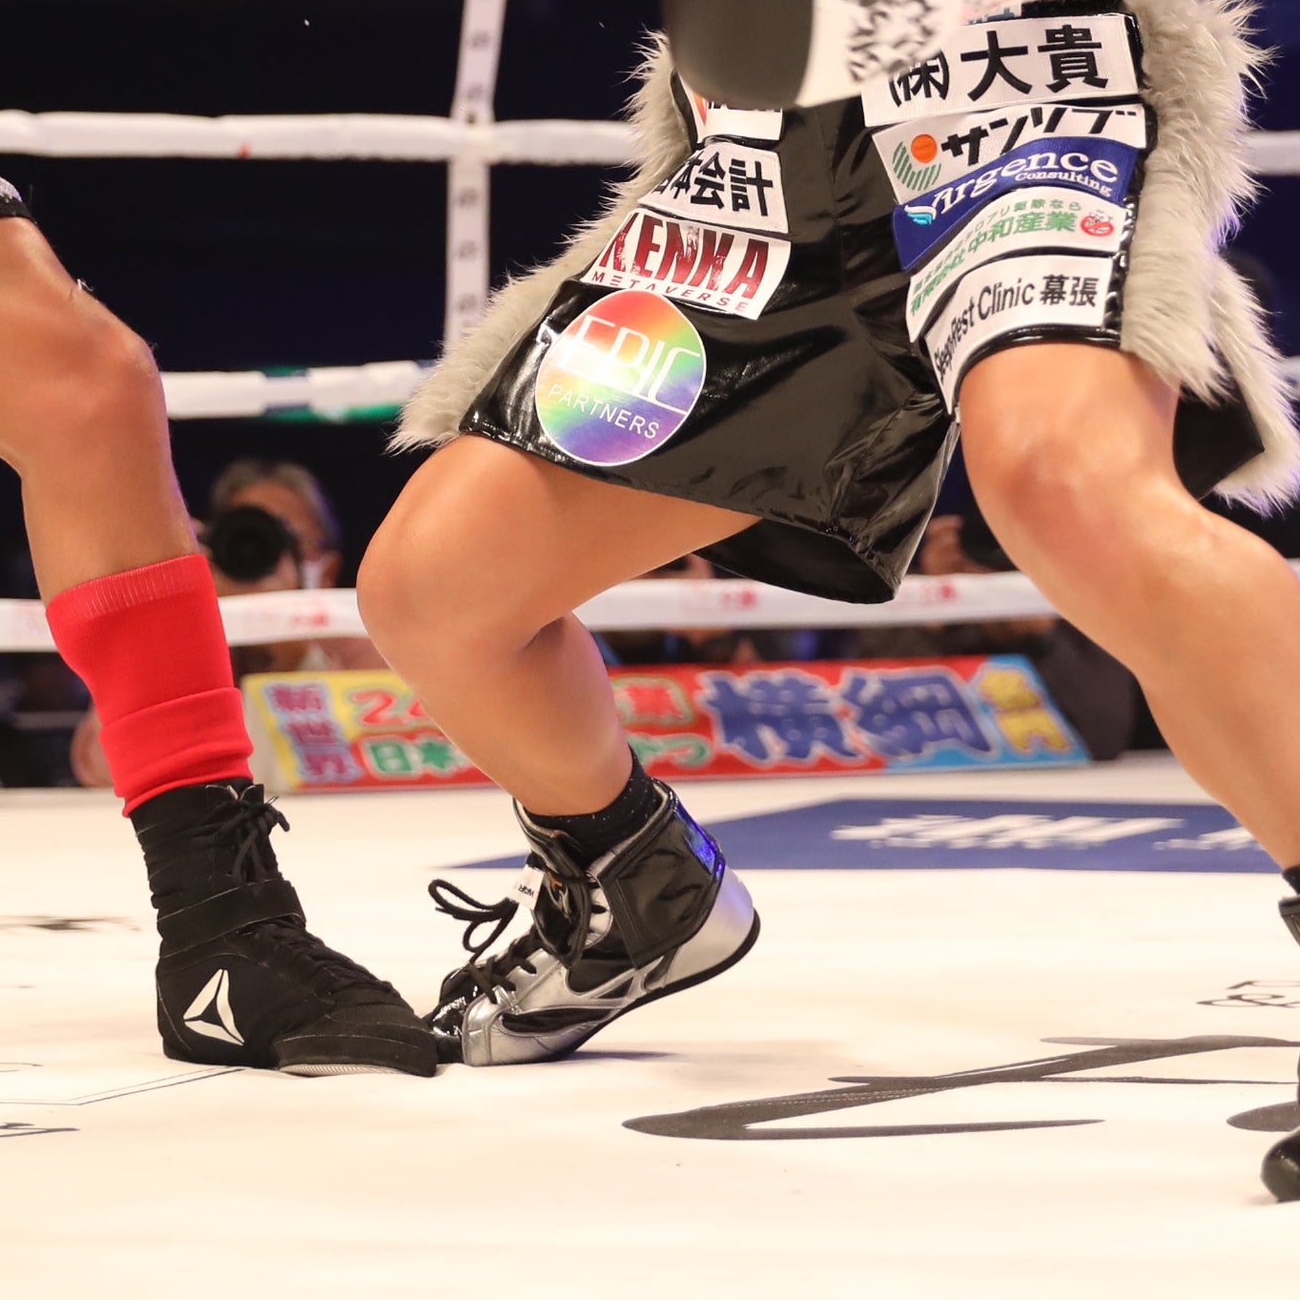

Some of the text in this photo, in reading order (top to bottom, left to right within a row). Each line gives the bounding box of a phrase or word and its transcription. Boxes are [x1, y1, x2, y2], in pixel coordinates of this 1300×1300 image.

[915, 152, 1118, 218] Argence
[1015, 169, 1113, 198] Consulting
[599, 212, 770, 300] KENKA
[591, 270, 750, 312] METAVERSE
[977, 277, 1035, 321] Clinic
[1039, 274, 1100, 307] 幕張
[558, 313, 701, 415] EPIC
[548, 383, 660, 439] PARTNERS
